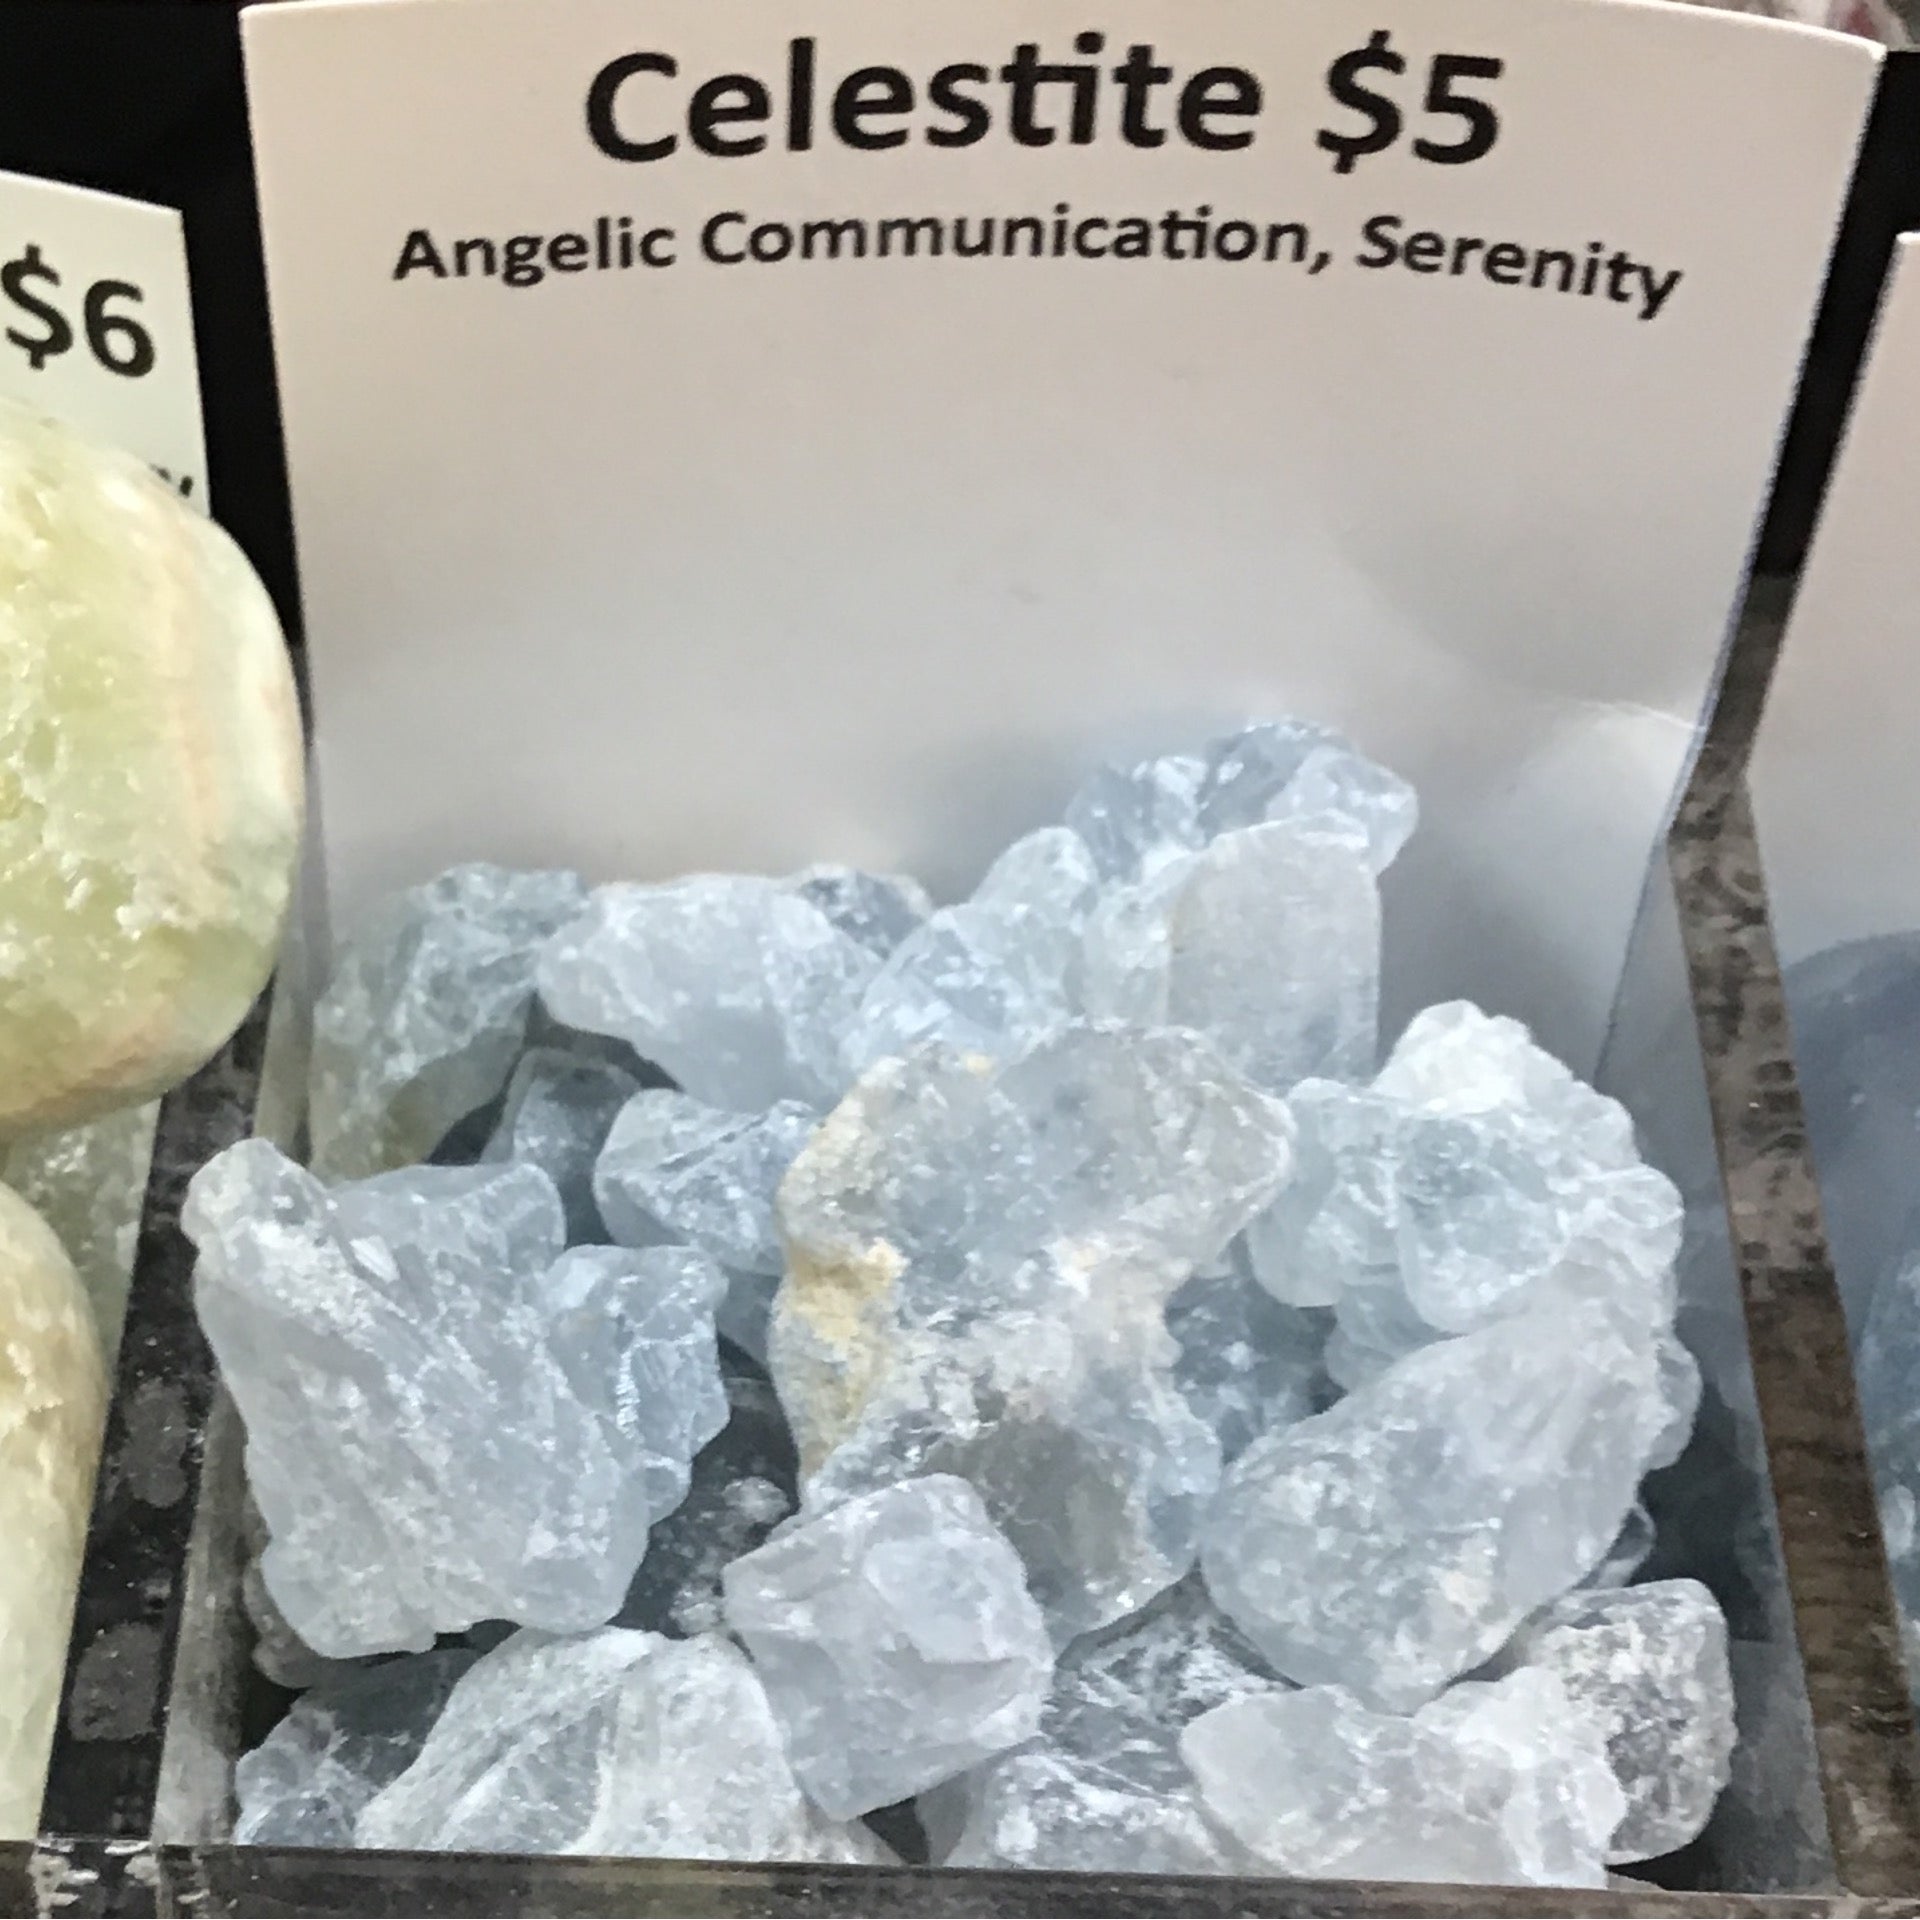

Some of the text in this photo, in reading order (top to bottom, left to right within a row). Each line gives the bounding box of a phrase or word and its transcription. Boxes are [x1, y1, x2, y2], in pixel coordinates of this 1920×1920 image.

[584, 28, 1507, 176] Celestite $5
[0, 243, 156, 379] $6
[391, 201, 1684, 322] Angelic Communication, Serenity
